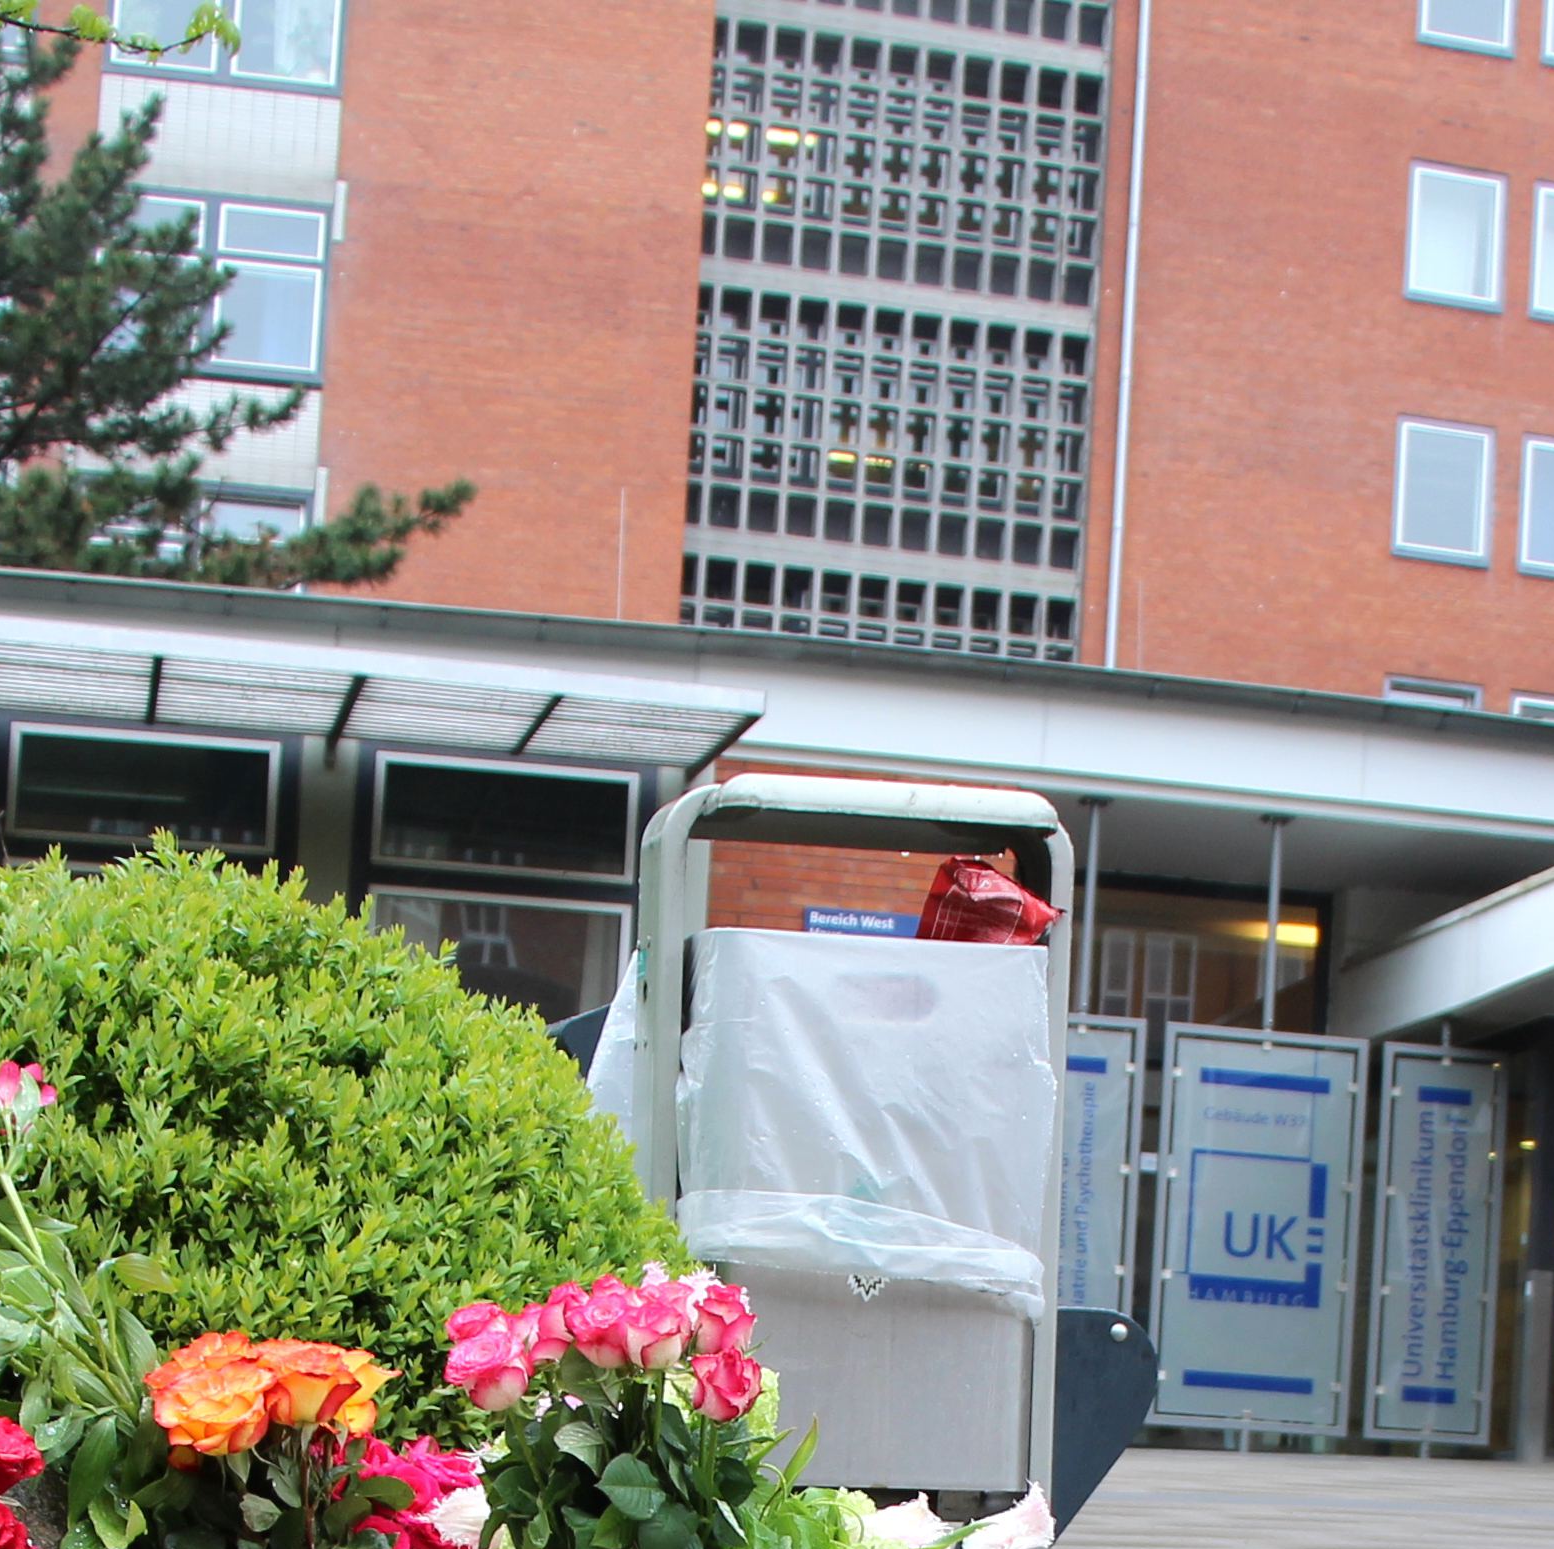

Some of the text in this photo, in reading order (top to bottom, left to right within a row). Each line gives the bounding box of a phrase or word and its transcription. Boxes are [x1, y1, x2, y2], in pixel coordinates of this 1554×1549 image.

[809, 910, 895, 929] Bereich West
[1074, 1082, 1098, 1215] Psychotherapie
[1073, 1219, 1088, 1254] und
[1435, 1114, 1471, 1380] Hamburg-Eppendorf
[1189, 1286, 1305, 1307] HAMBURG
